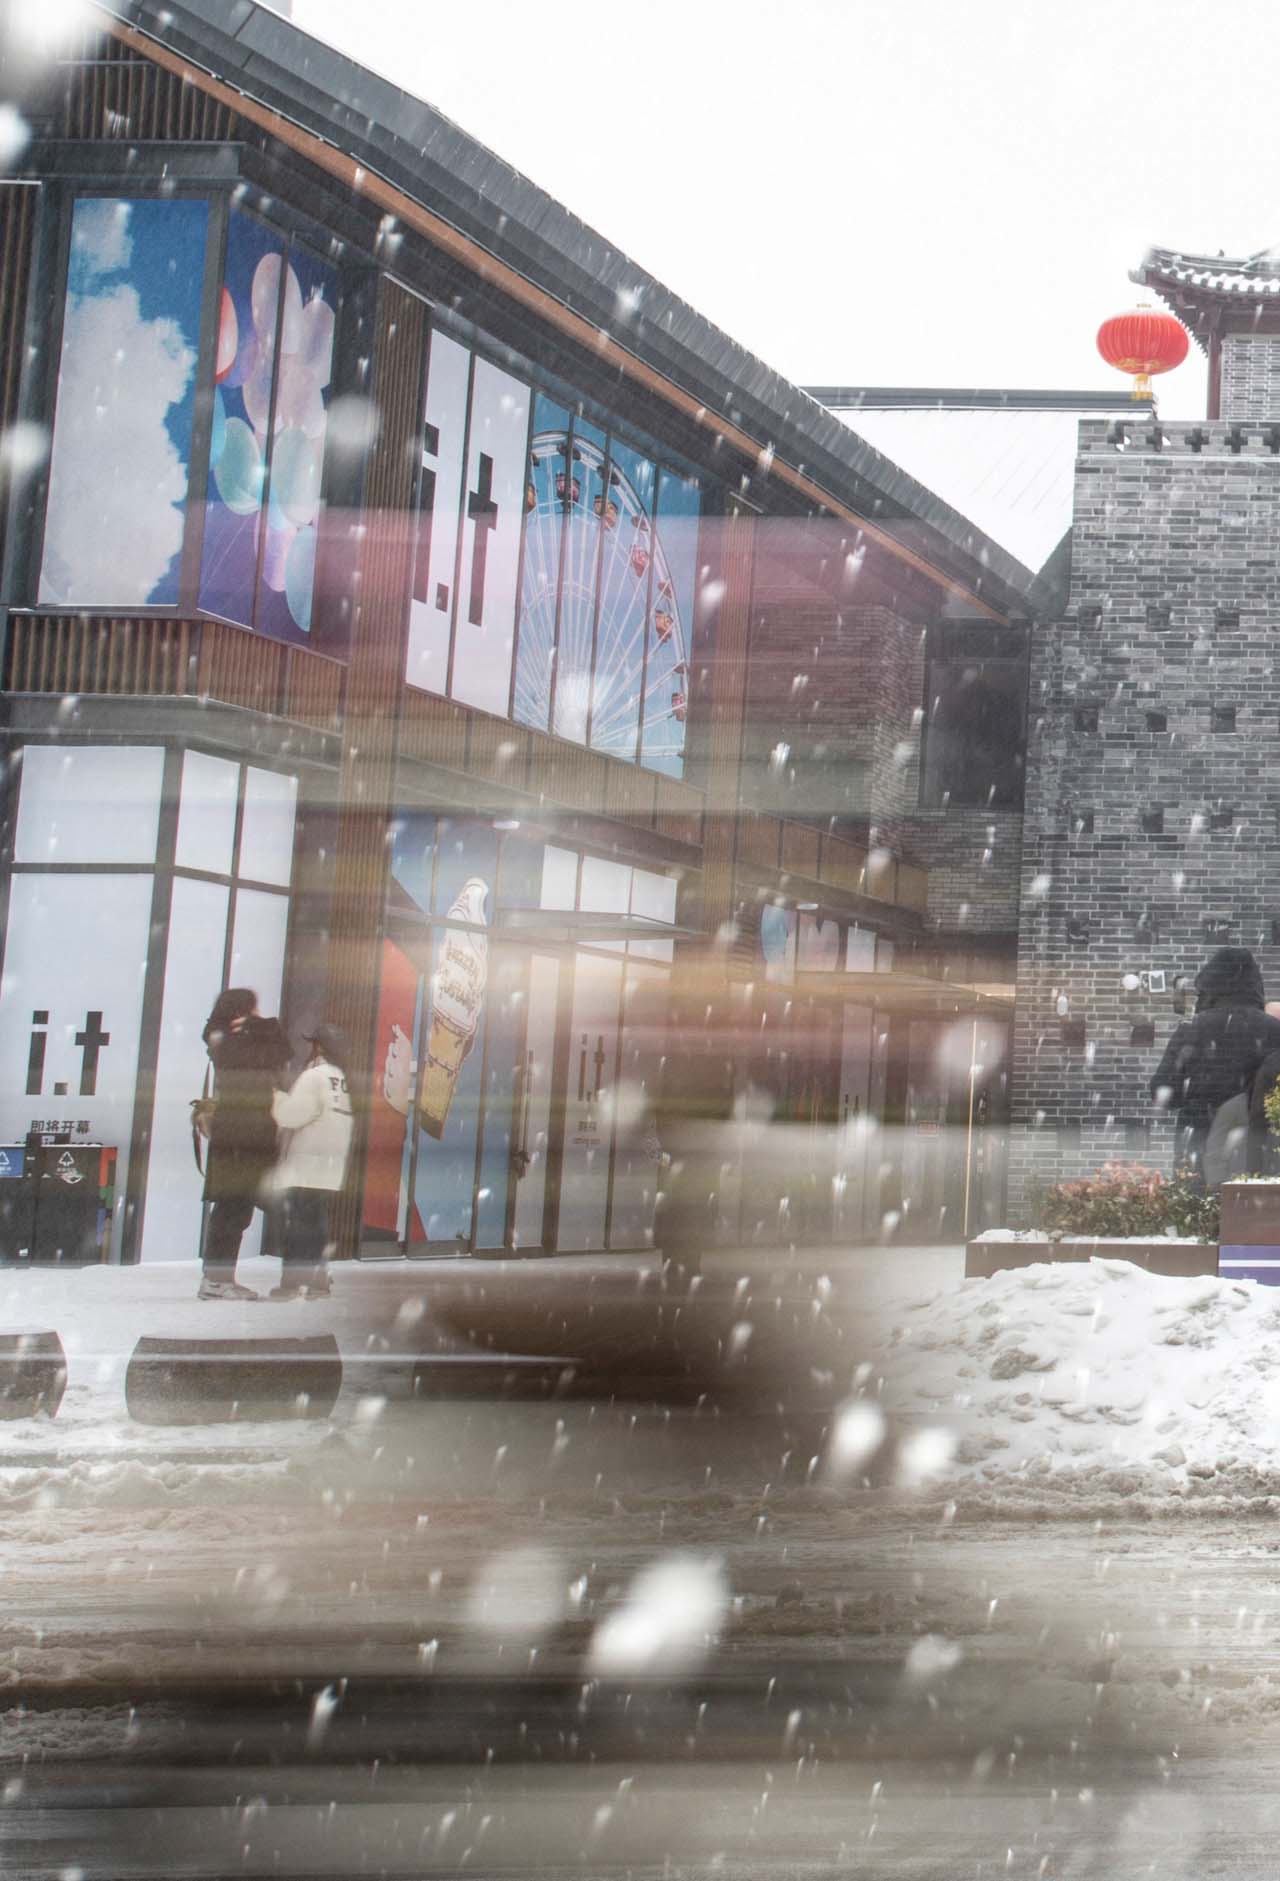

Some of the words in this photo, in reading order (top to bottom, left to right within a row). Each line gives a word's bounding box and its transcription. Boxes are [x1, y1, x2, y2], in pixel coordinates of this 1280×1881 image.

[25, 1010, 110, 1096] i.t
[31, 1120, 91, 1134] 即将开幕
